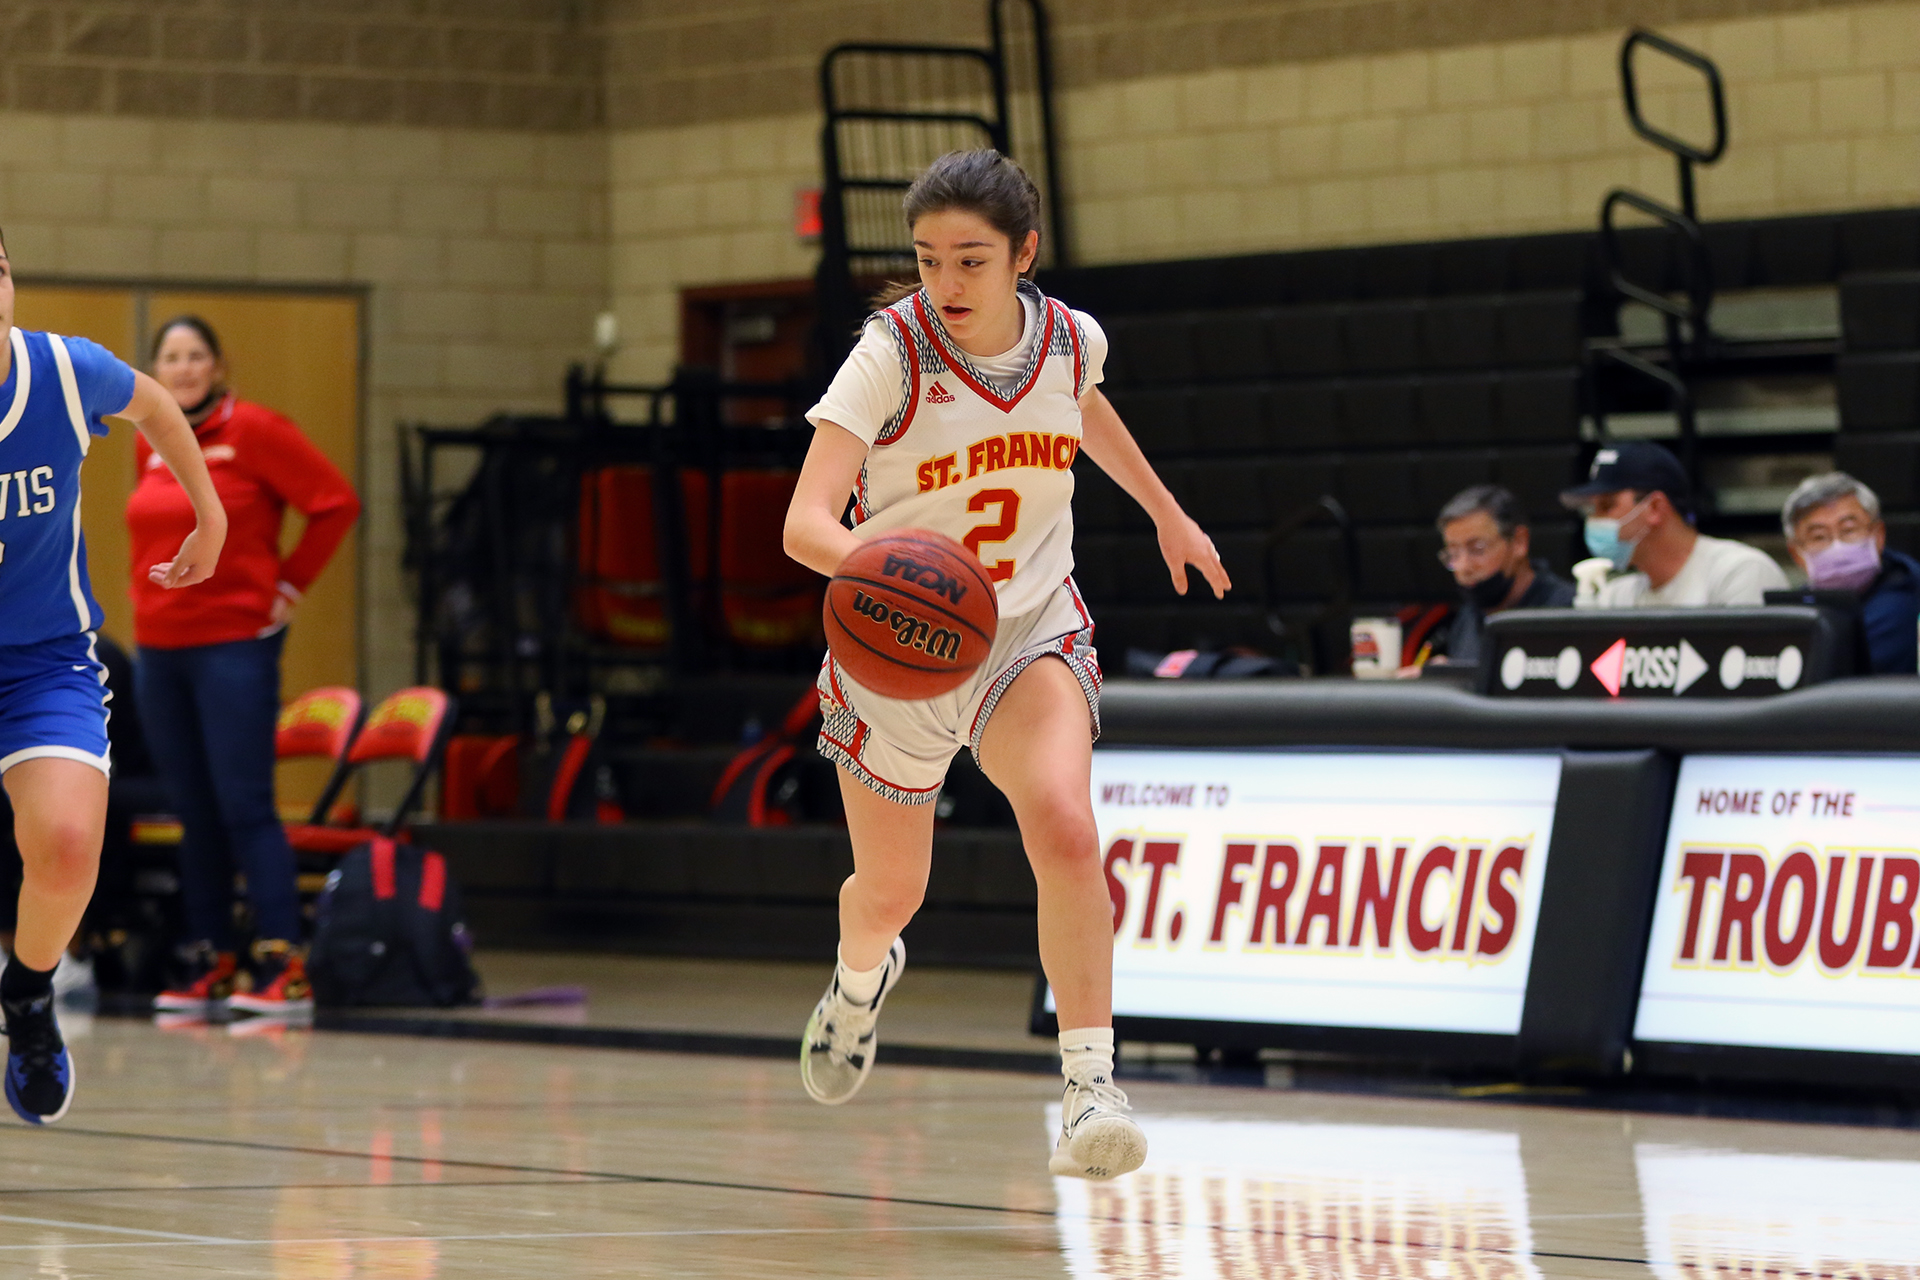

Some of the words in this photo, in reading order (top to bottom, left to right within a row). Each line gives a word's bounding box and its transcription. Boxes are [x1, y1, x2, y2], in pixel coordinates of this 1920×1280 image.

[926, 393, 955, 404] adidas
[916, 451, 963, 495] ST.
[962, 488, 1022, 583] 2
[881, 553, 968, 606] NCAA
[853, 589, 962, 663] Wilson
[1619, 646, 1678, 688] POSS
[1101, 783, 1196, 807] WELCOME
[1205, 784, 1230, 808] TO
[1697, 789, 1763, 815] HOME
[1771, 790, 1801, 816] OF
[1810, 791, 1855, 817] THE
[1102, 829, 1187, 949] ST.
[1204, 834, 1534, 966] FRANCIS
[1672, 842, 1920, 978] TROUB
